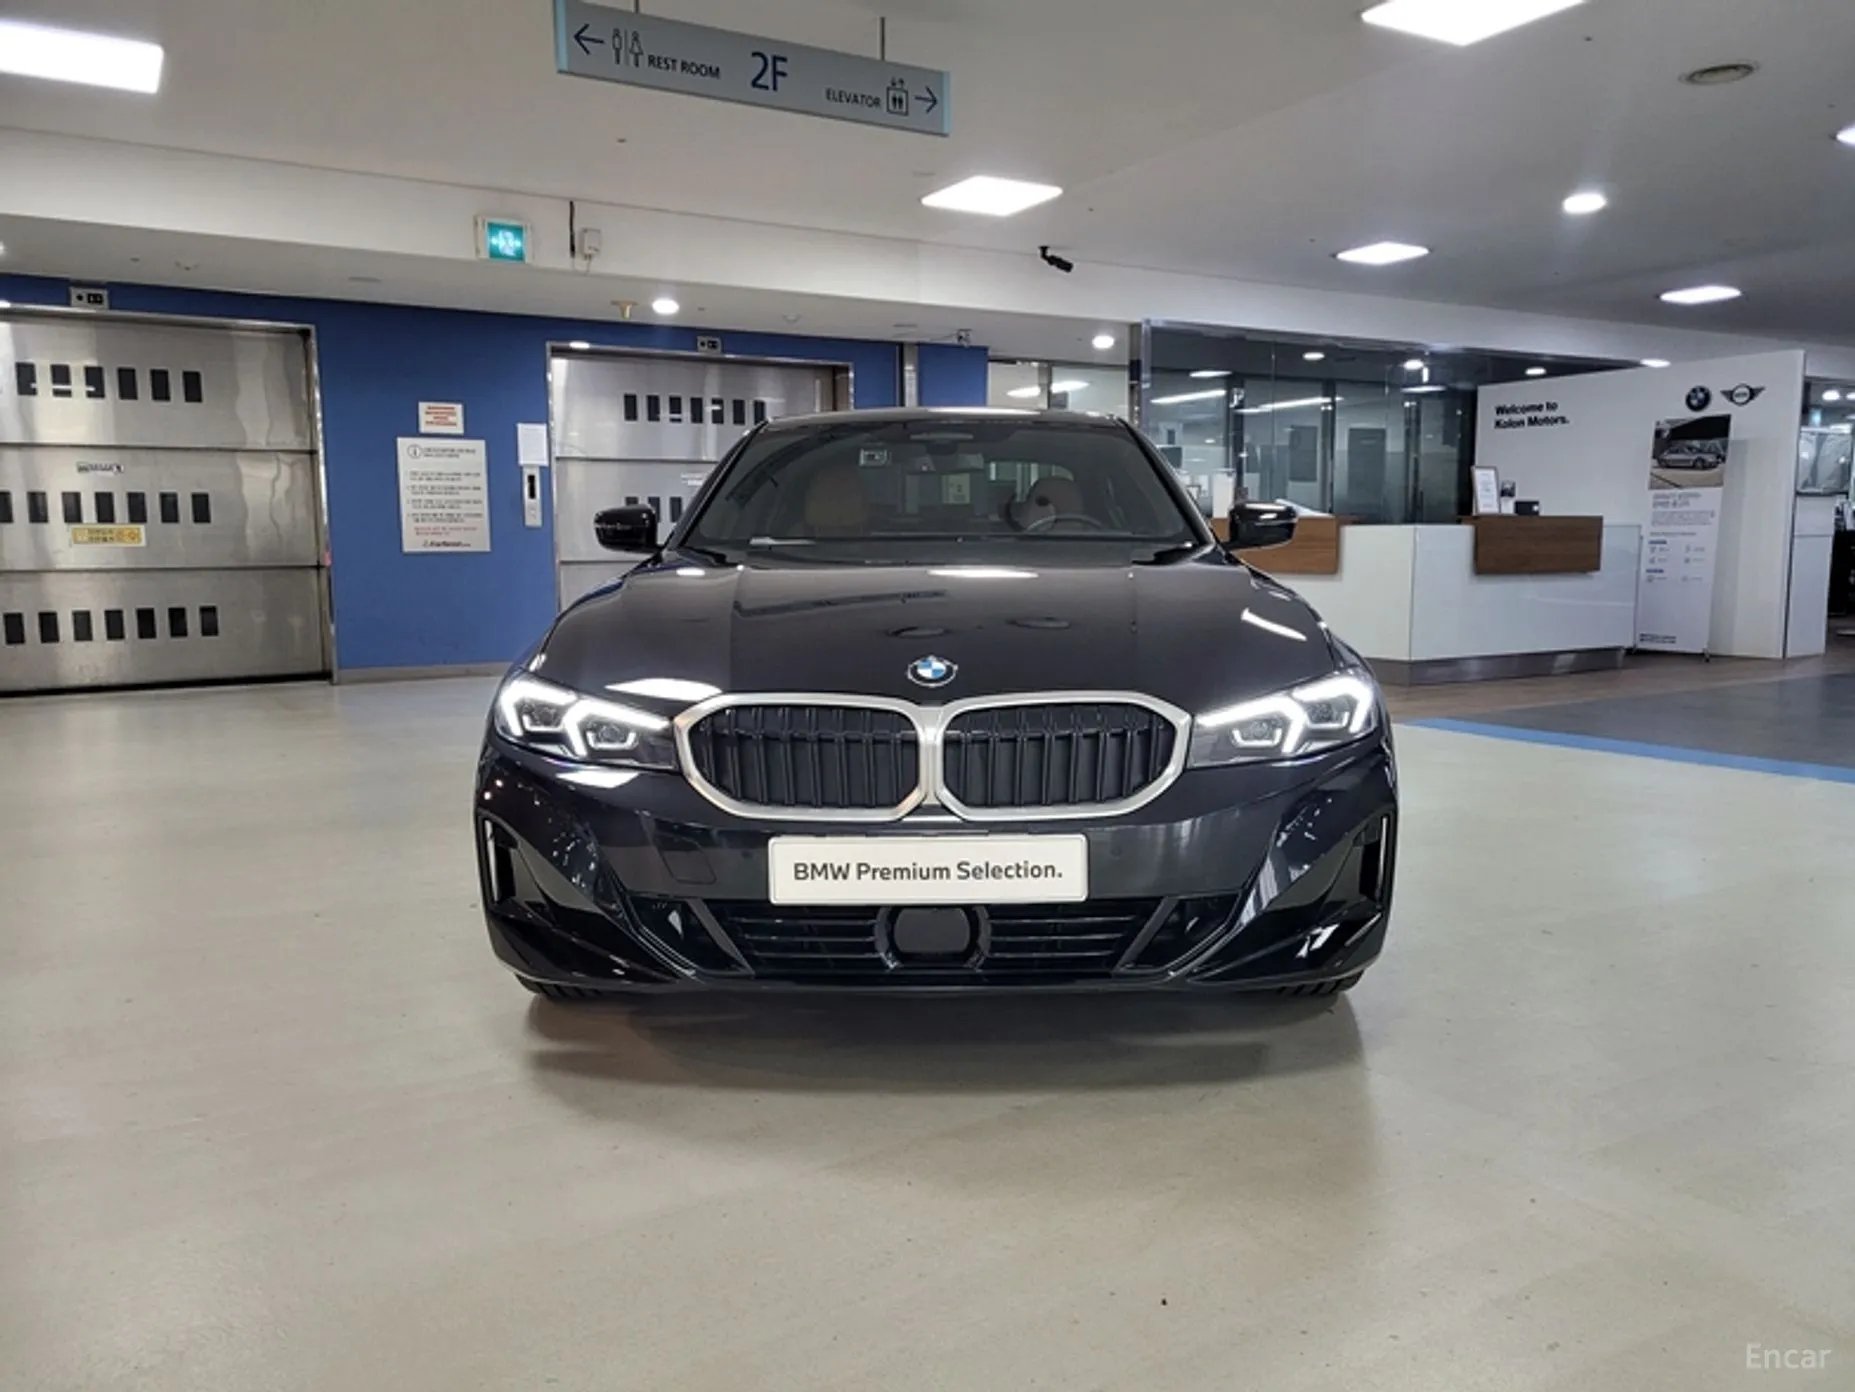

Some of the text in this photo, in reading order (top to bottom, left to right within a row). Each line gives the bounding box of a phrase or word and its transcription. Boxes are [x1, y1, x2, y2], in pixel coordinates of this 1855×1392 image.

[648, 54, 720, 79] REST ROOM
[751, 51, 788, 92] 2F
[825, 87, 881, 108] ELEVATOR
[1495, 401, 1558, 416] Welcome to
[1495, 416, 1570, 429] Kolon Motors.
[793, 860, 1063, 881] BMW Premium Selection.
